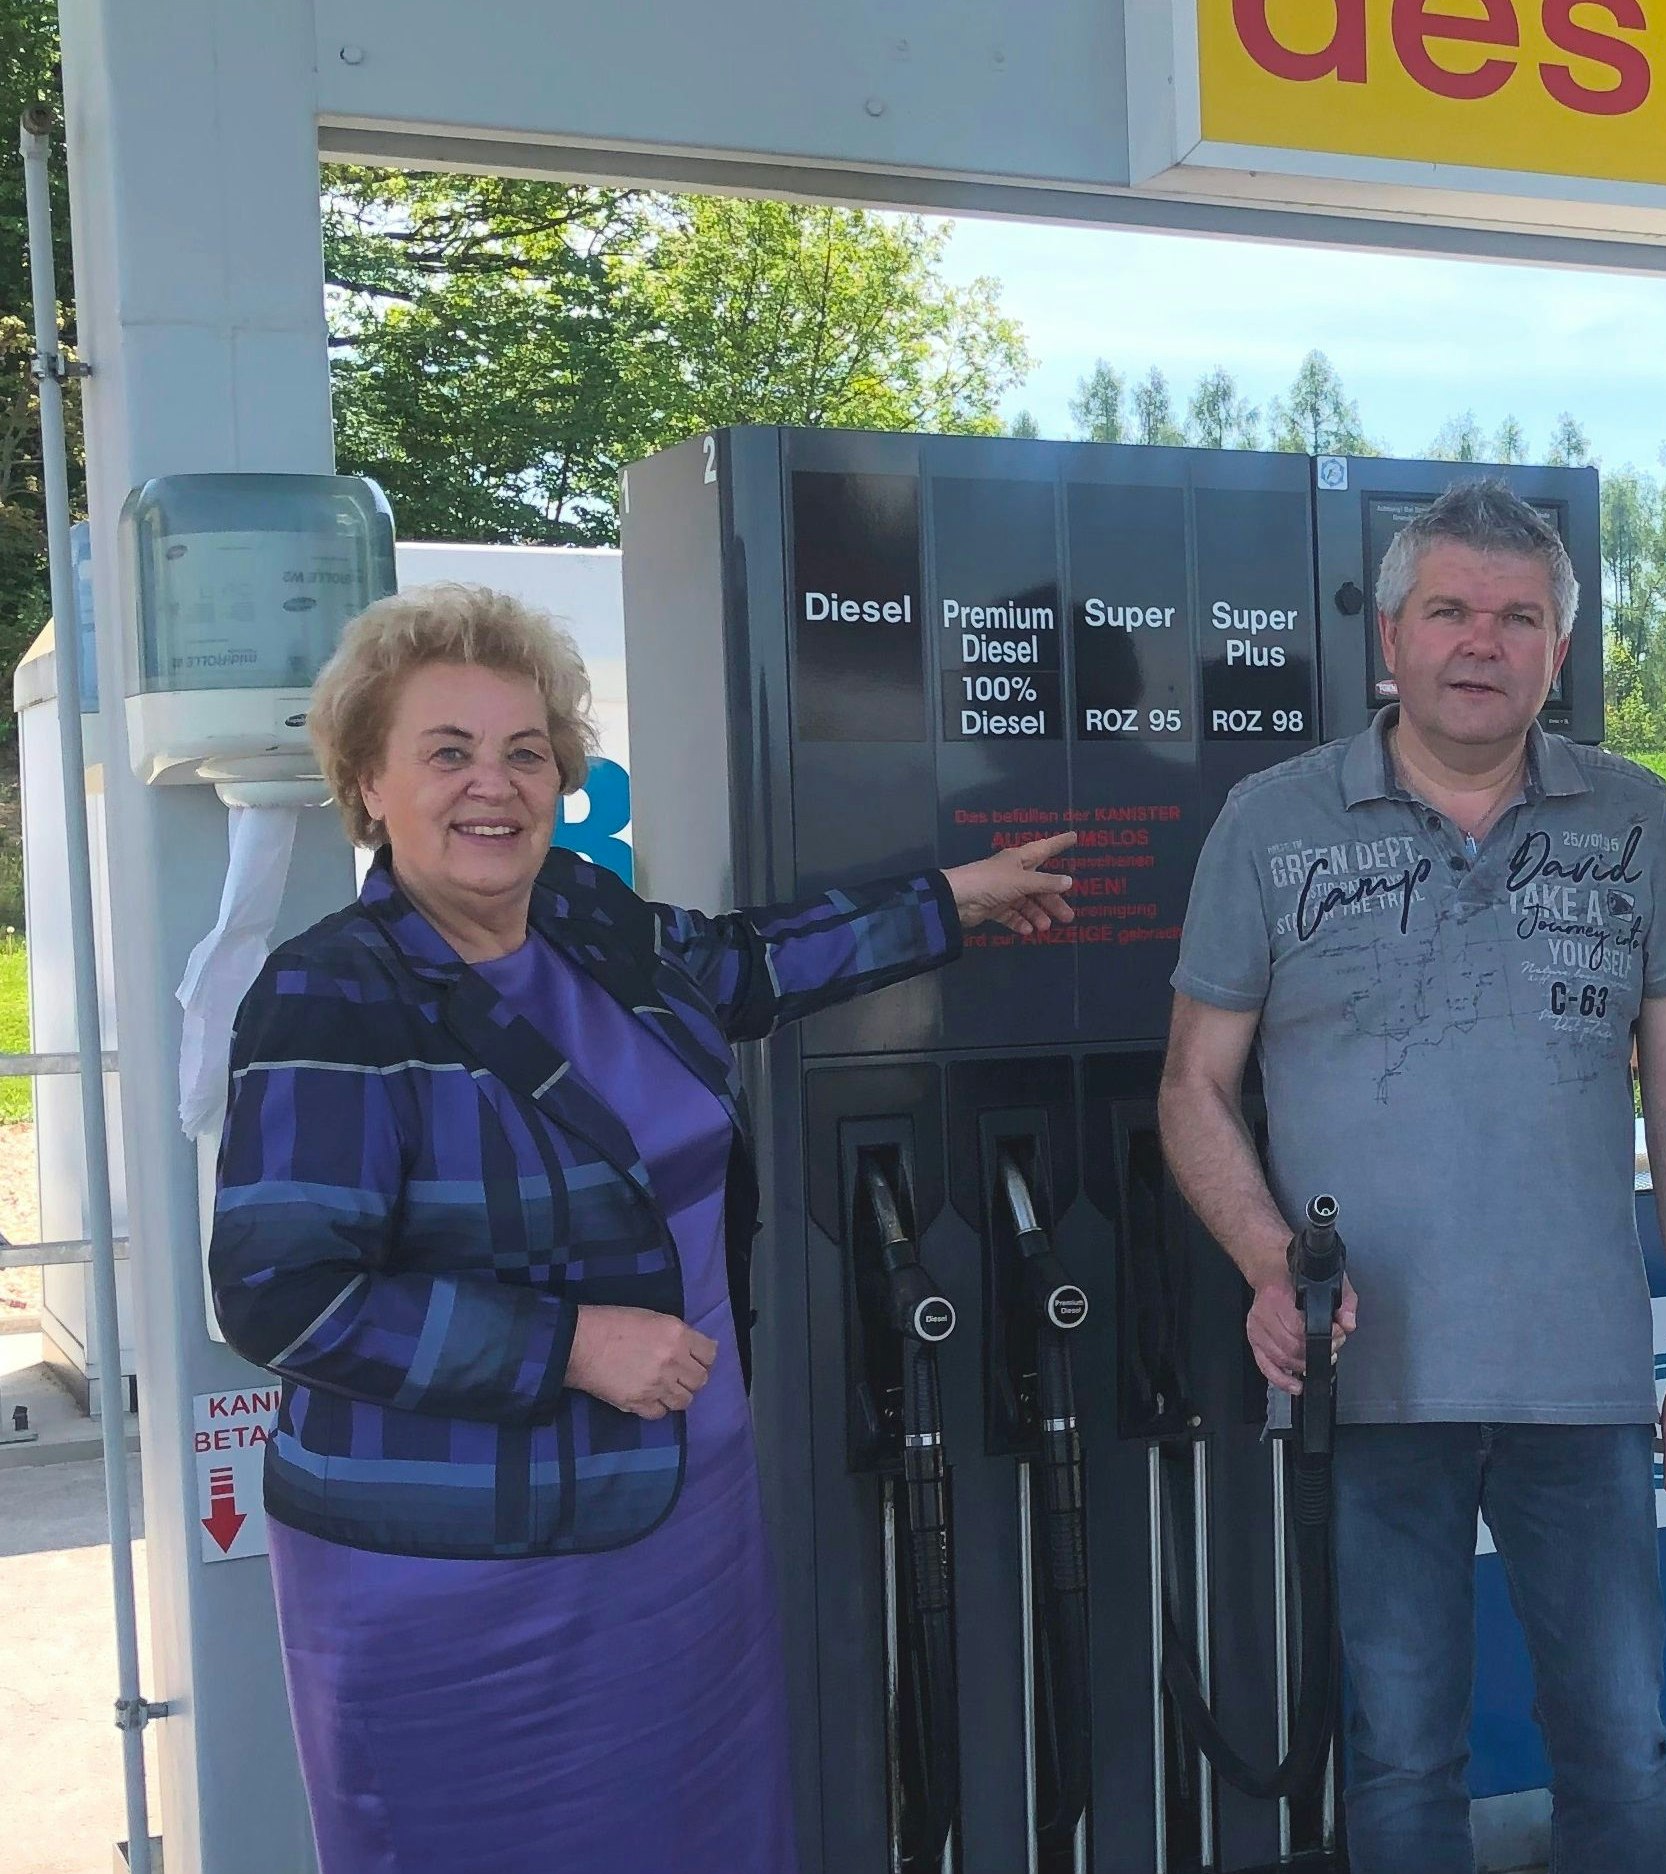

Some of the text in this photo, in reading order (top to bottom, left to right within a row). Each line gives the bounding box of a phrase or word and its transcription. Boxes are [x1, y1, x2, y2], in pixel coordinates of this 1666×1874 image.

[703, 435, 717, 485] 2
[805, 591, 912, 624] Diesel
[943, 599, 1054, 630] Premium
[1084, 598, 1176, 633] Super
[1211, 601, 1298, 635] Super
[961, 633, 1039, 664] Diesel
[1226, 639, 1286, 667] Plus
[962, 676, 1037, 702] 100%
[961, 710, 1046, 735] Diesel
[1085, 709, 1182, 732] ROZ 95
[1212, 709, 1304, 732] ROZ 98
[1094, 805, 1181, 821] KANISTER
[1269, 844, 1349, 889] GREEN
[1506, 825, 1643, 892] David
[1297, 857, 1432, 942] Camp
[1551, 981, 1609, 1019] C-63
[925, 1315, 948, 1323] Diesel
